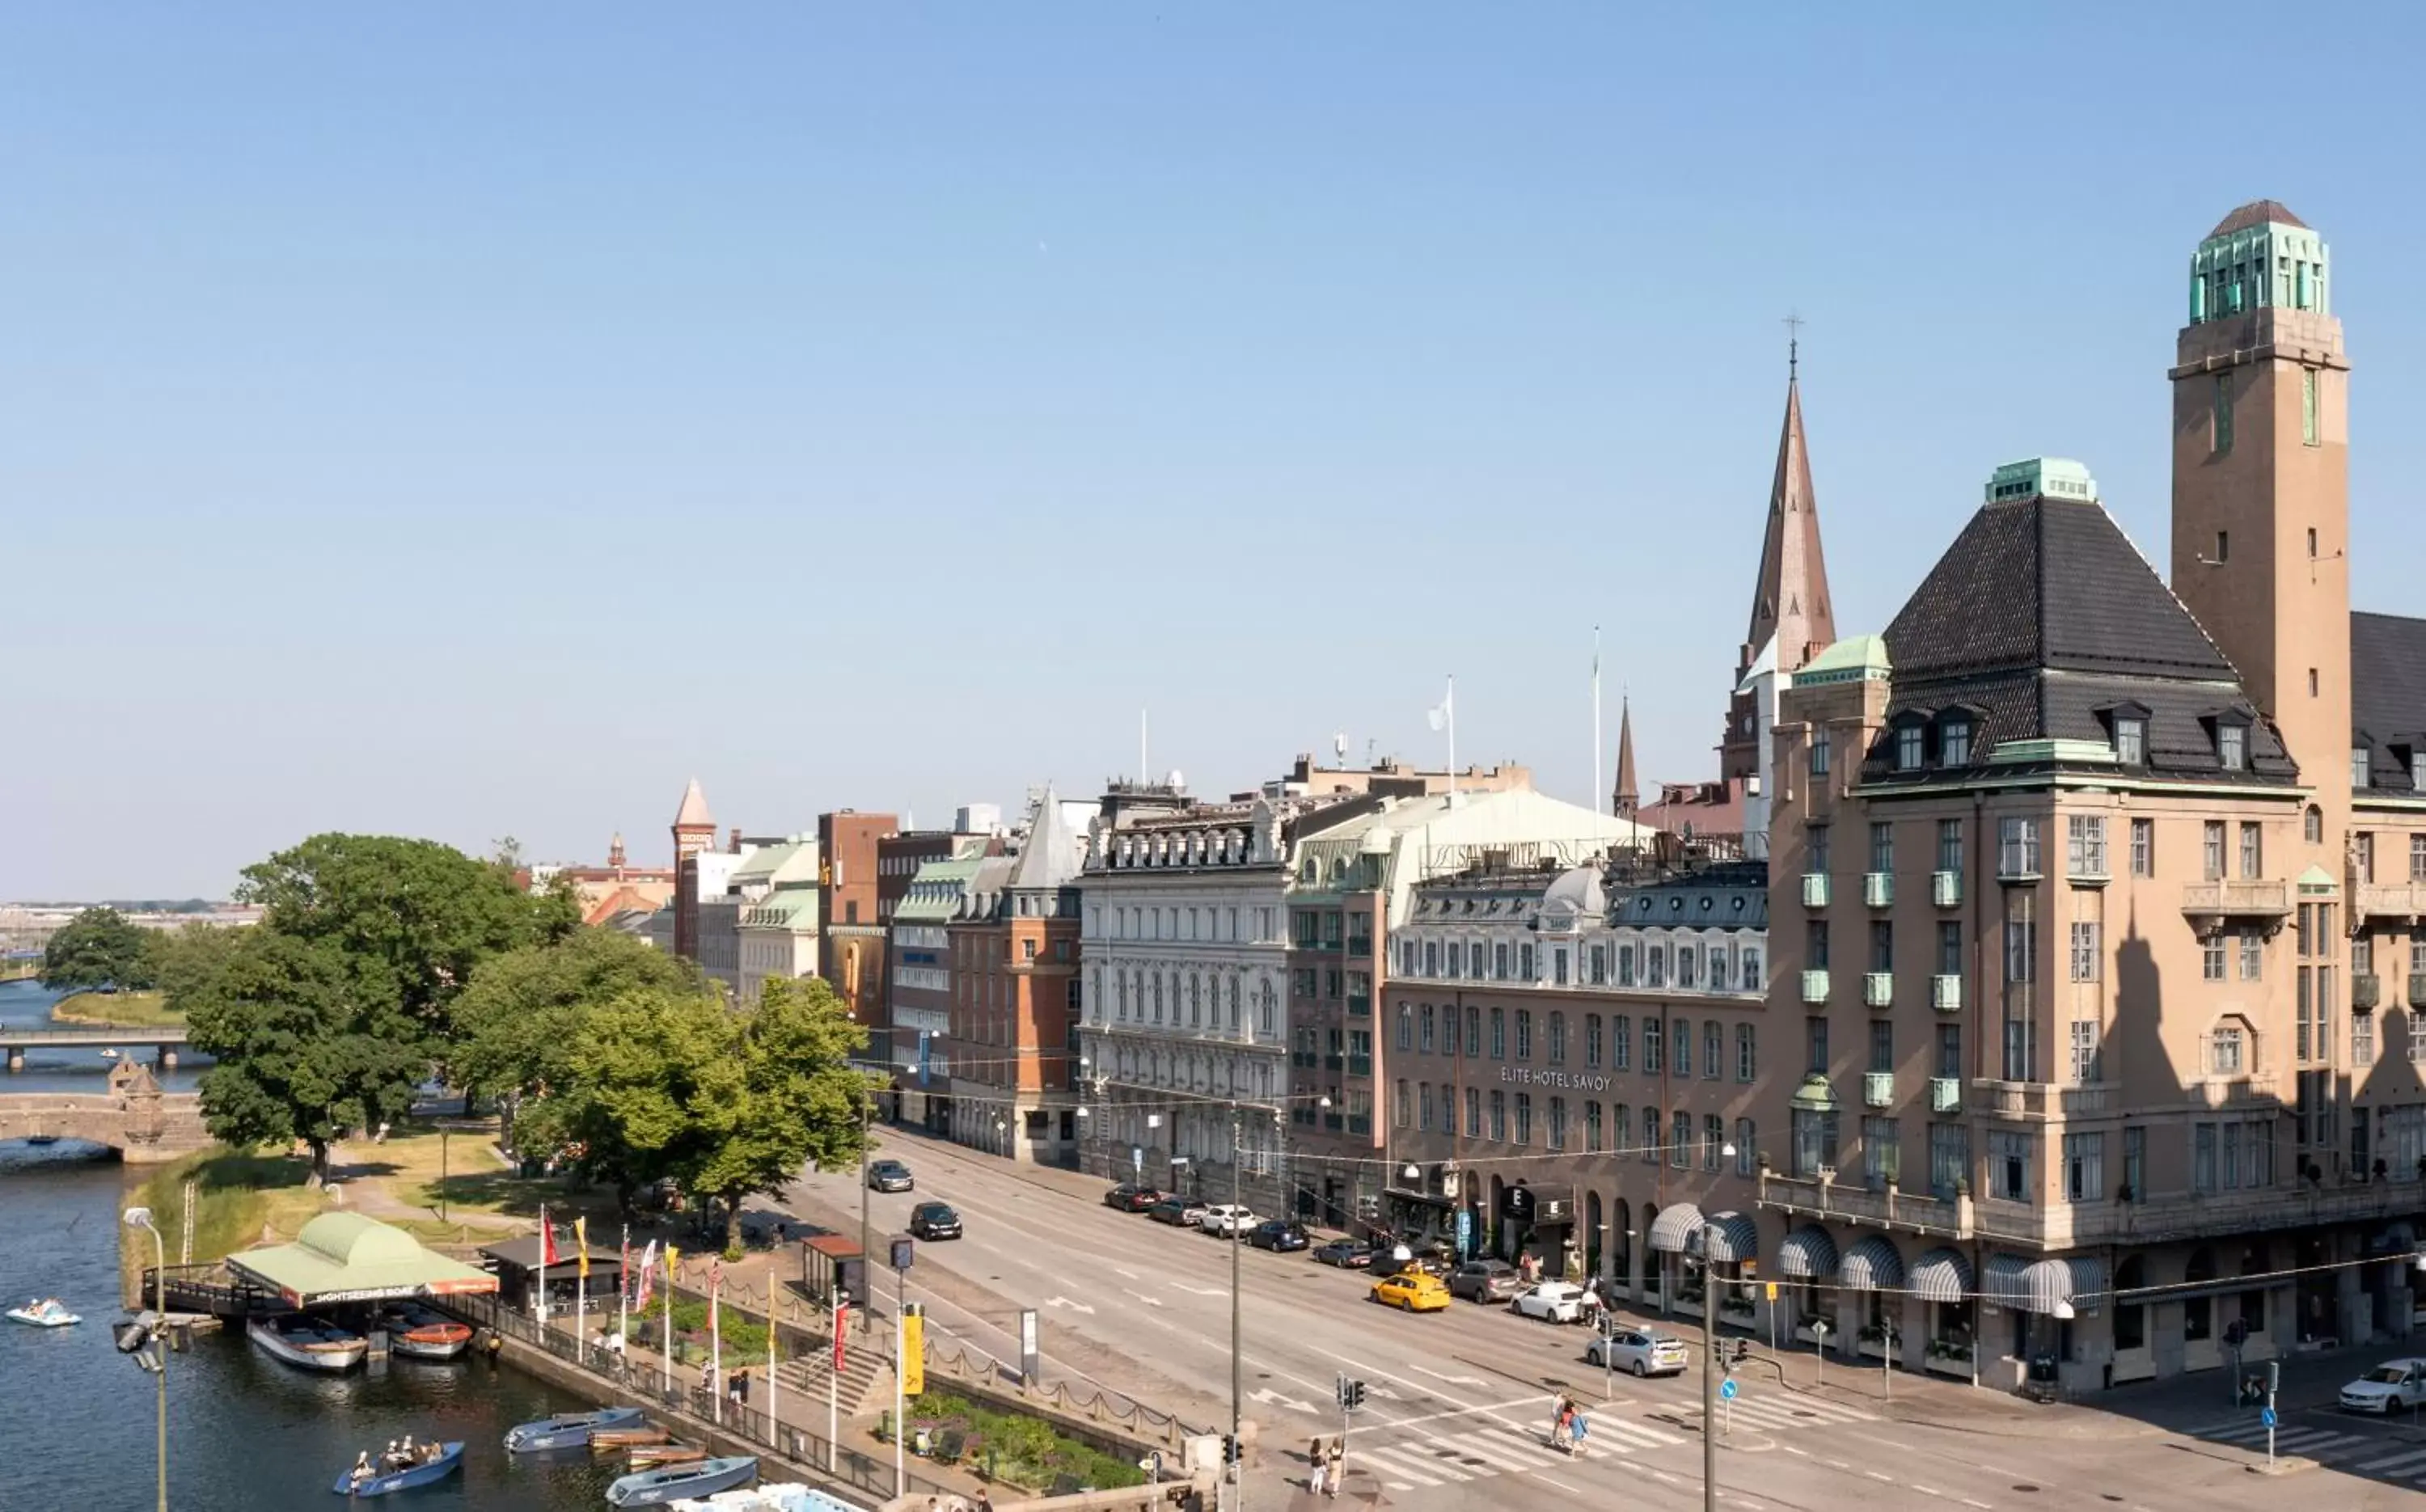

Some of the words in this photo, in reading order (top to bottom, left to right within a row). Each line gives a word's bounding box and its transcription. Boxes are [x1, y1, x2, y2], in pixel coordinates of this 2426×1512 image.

[1502, 1066, 1530, 1083] ELITE
[1533, 1069, 1570, 1088] HOTEL
[1573, 1074, 1612, 1092] SAVOY
[1513, 1189, 1521, 1206] E
[1550, 1202, 1558, 1213] E
